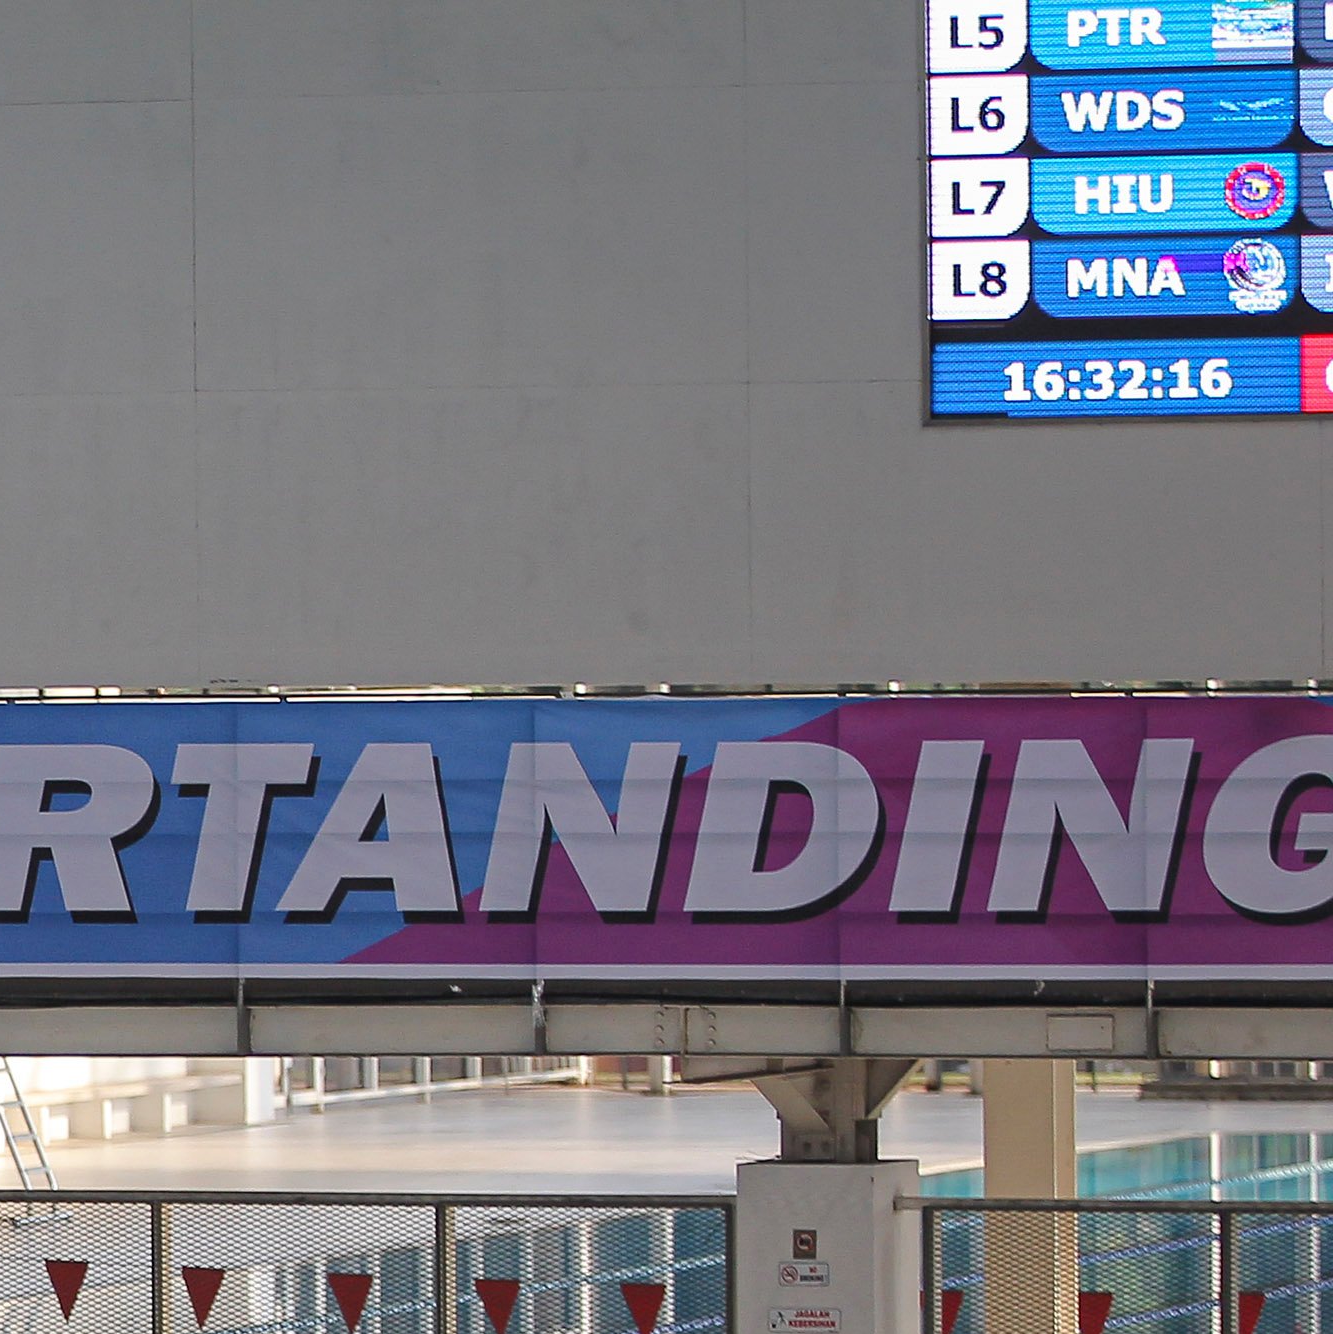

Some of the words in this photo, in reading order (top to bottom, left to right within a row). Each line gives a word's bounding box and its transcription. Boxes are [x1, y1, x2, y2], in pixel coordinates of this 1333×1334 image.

[950, 14, 1004, 48] L5
[1066, 9, 1166, 47] PTR
[951, 97, 1005, 132] L6
[1061, 90, 1185, 132] WDS
[951, 181, 1006, 216] L7
[1074, 175, 1174, 214] HIU
[953, 263, 1006, 297] L8
[1066, 256, 1186, 297] MNA
[1003, 359, 1233, 401] 16:32:16
